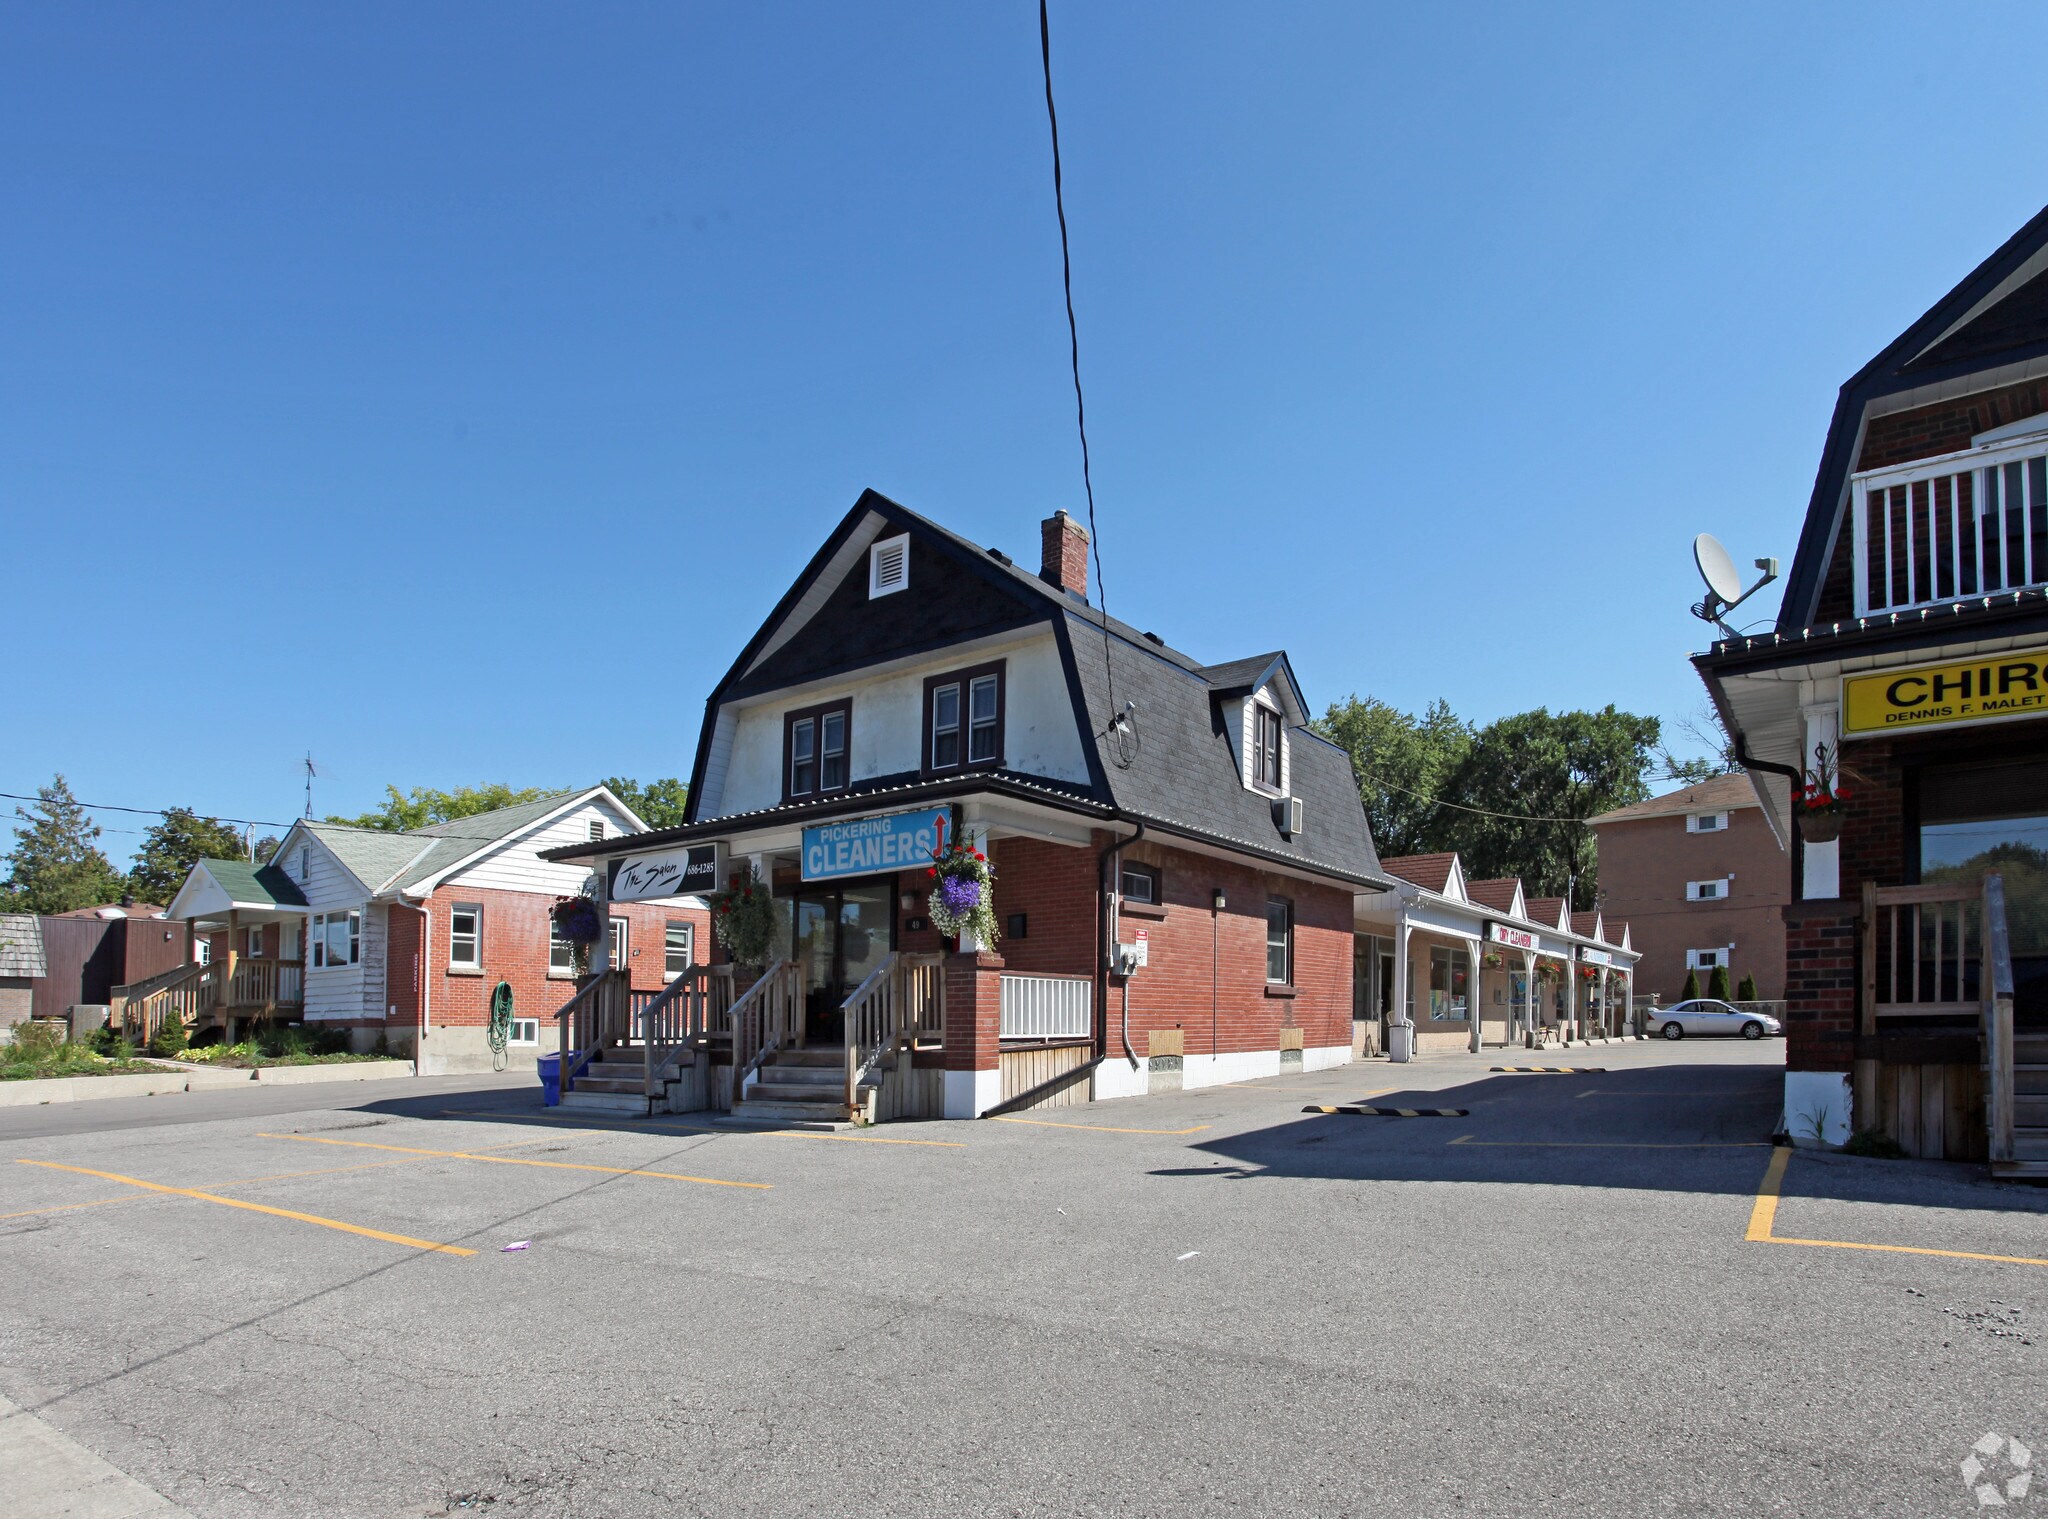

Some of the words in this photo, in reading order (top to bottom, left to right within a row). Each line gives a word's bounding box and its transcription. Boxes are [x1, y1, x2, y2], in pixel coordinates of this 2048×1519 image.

[1885, 661, 2048, 707] CHIR
[1885, 706, 1953, 723] DENNIS
[1961, 703, 1974, 714] F.
[820, 818, 892, 843] PICKERING
[808, 828, 932, 875] CLEANERS
[638, 859, 678, 894] Salon
[687, 861, 715, 876] 686-1285
[911, 920, 920, 929] 49
